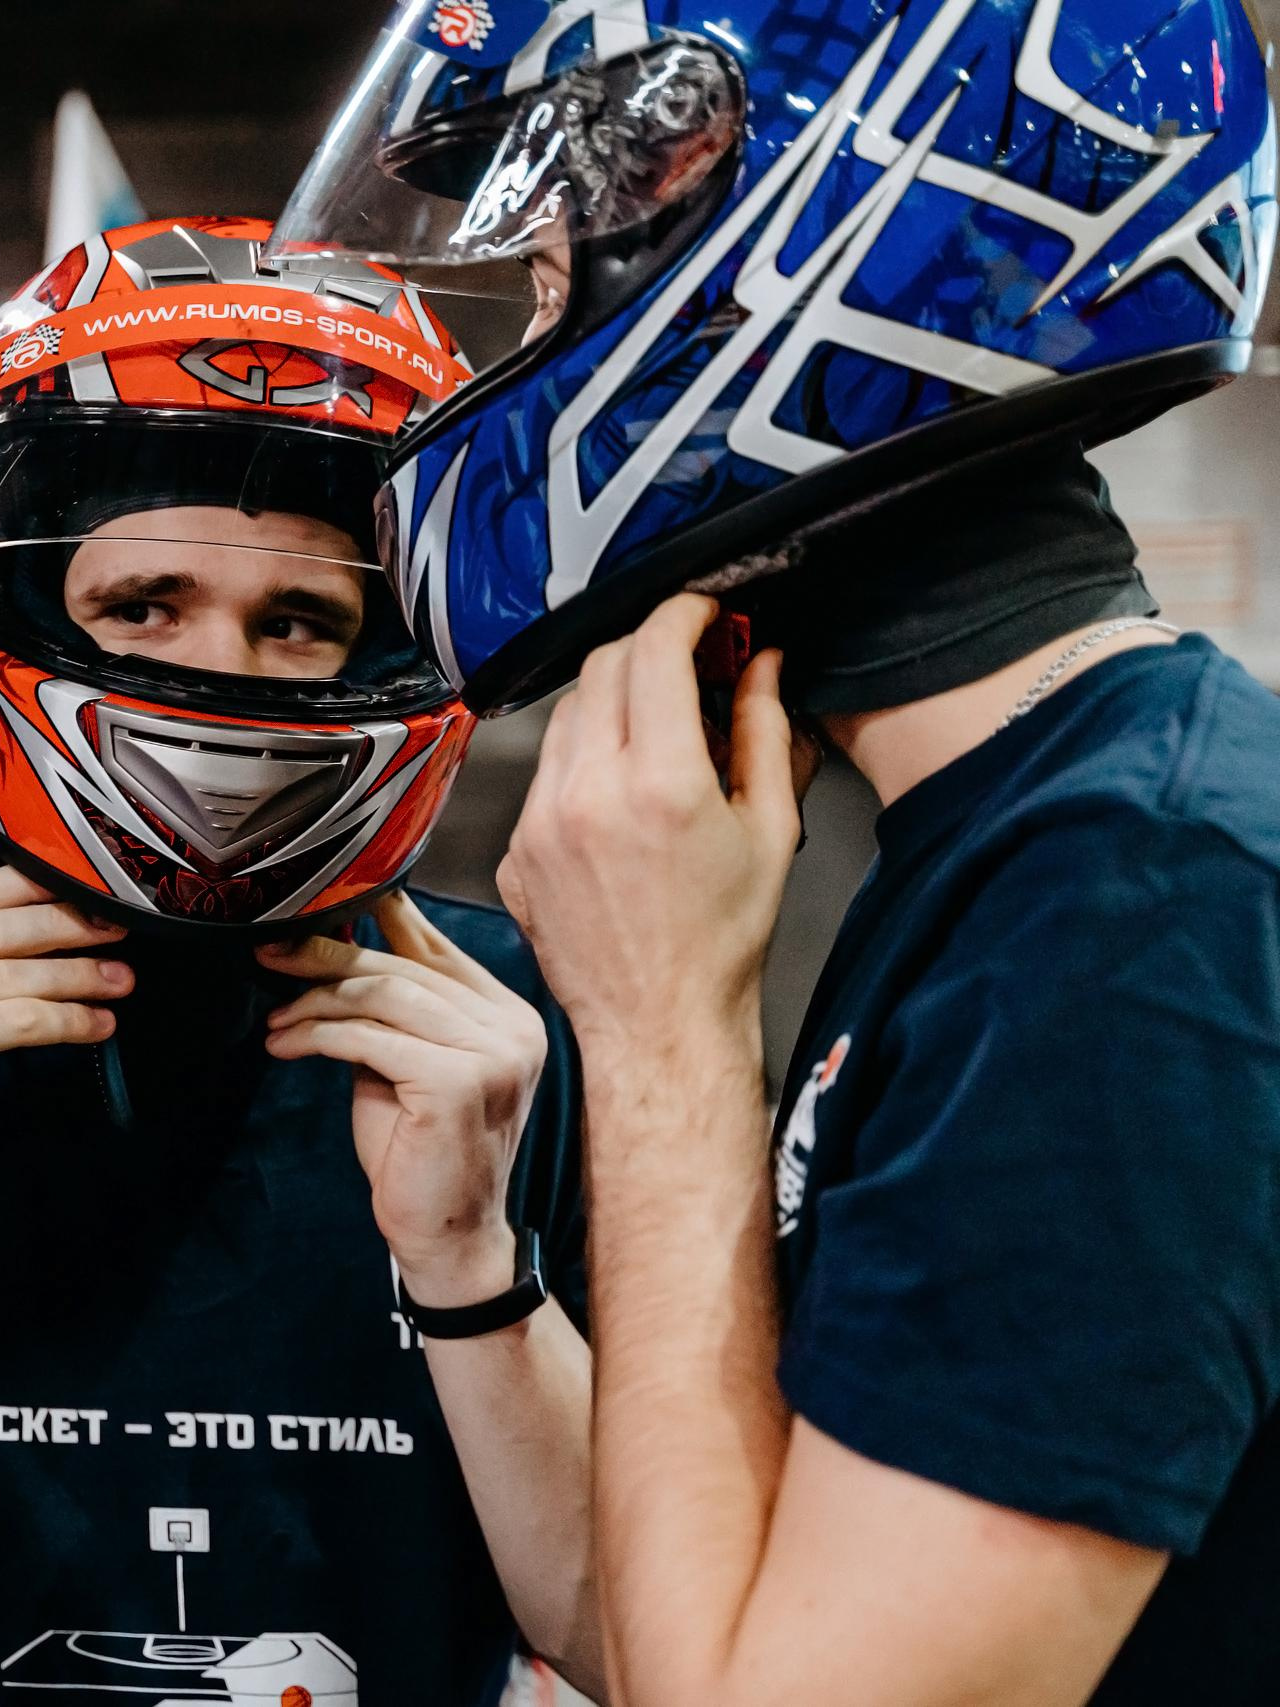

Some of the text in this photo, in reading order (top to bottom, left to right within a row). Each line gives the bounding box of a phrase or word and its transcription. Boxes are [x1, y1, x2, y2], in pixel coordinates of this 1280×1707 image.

[83, 303, 444, 385] WWW.RUMOS-SPORT.RU
[165, 1411, 255, 1450] ЭТО
[267, 1414, 415, 1456] СТИЛЬ
